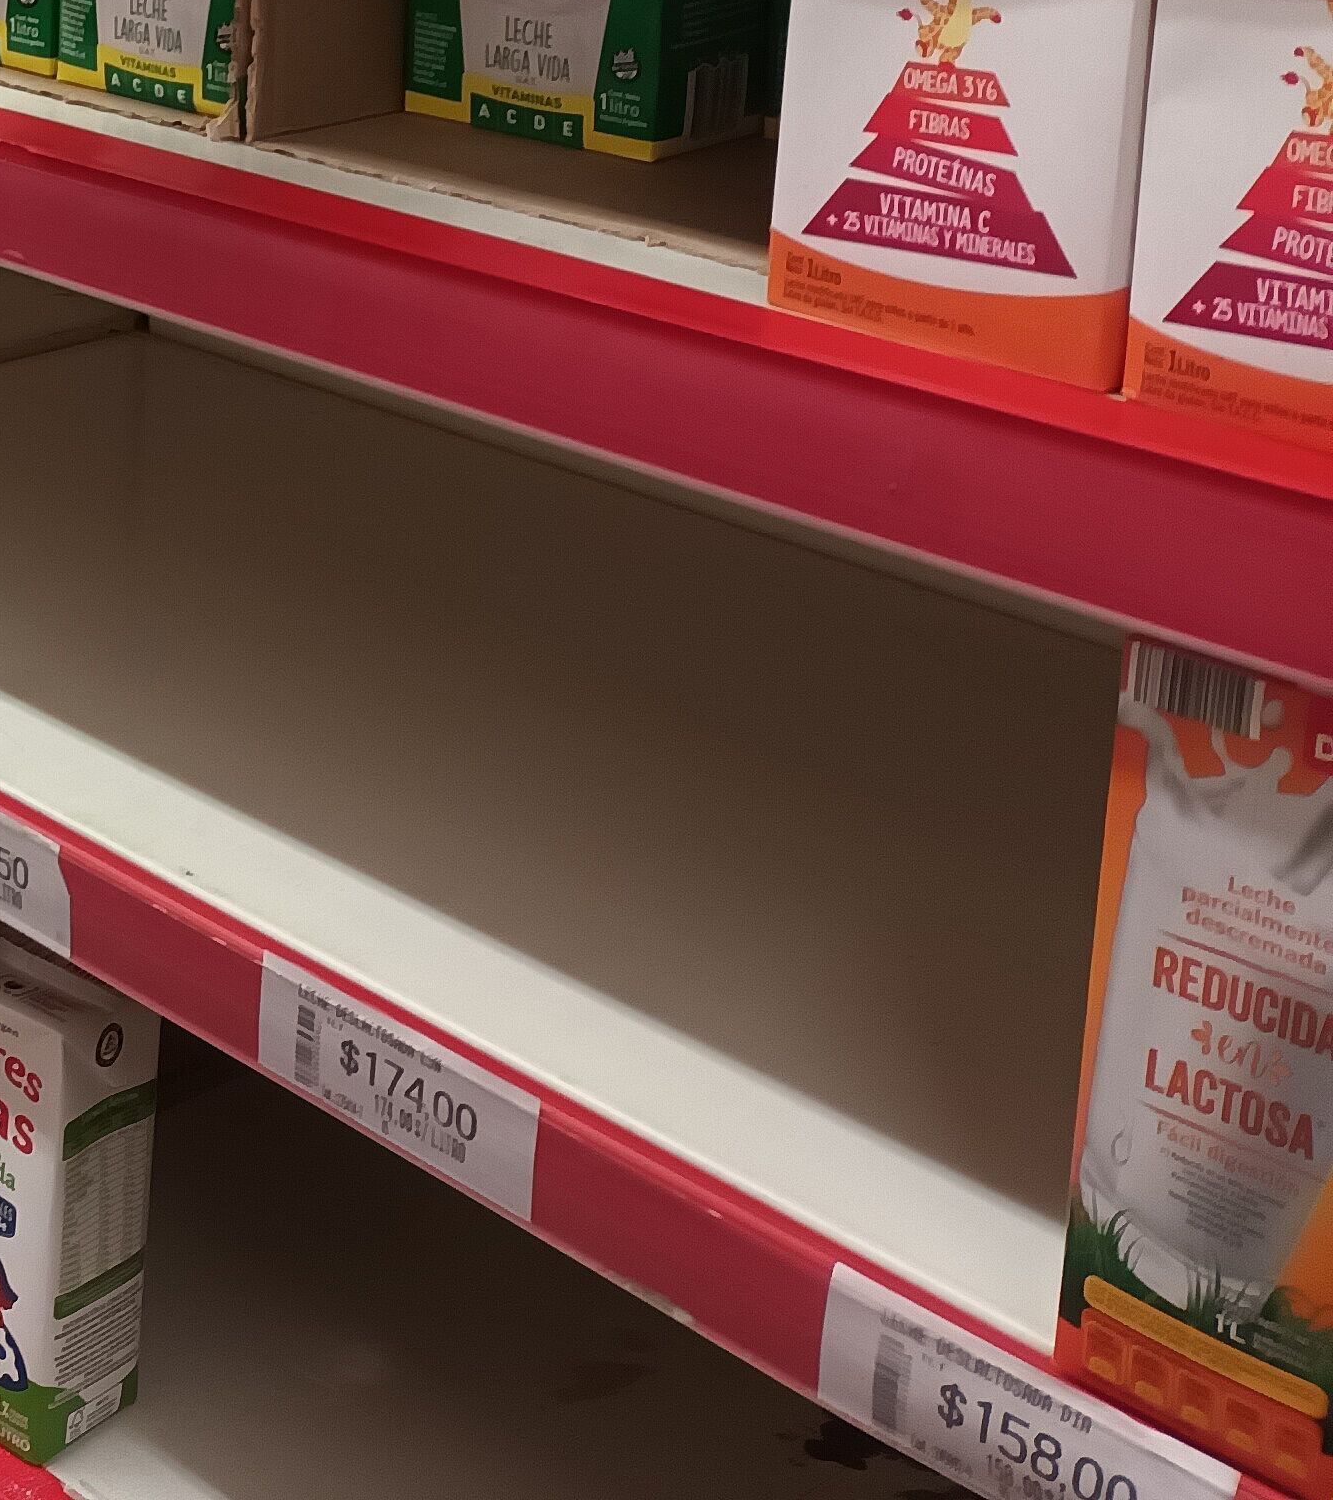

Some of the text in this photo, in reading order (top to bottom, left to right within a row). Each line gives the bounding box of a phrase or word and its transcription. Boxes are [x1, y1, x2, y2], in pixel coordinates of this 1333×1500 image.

[114, 18, 183, 54] LARGA VIDA
[504, 16, 552, 49] LECHE
[485, 44, 570, 81] LARGA VIDA
[904, 69, 958, 95] OMEGA
[909, 109, 970, 140] FIBRAS
[893, 146, 995, 197] PROTEÍNAS
[880, 193, 990, 233] VITAMINA C
[864, 215, 1036, 264] VITAMINAS MINERALES
[339, 1039, 478, 1142] $174,00
[1145, 1047, 1315, 1161] LACTOSA
